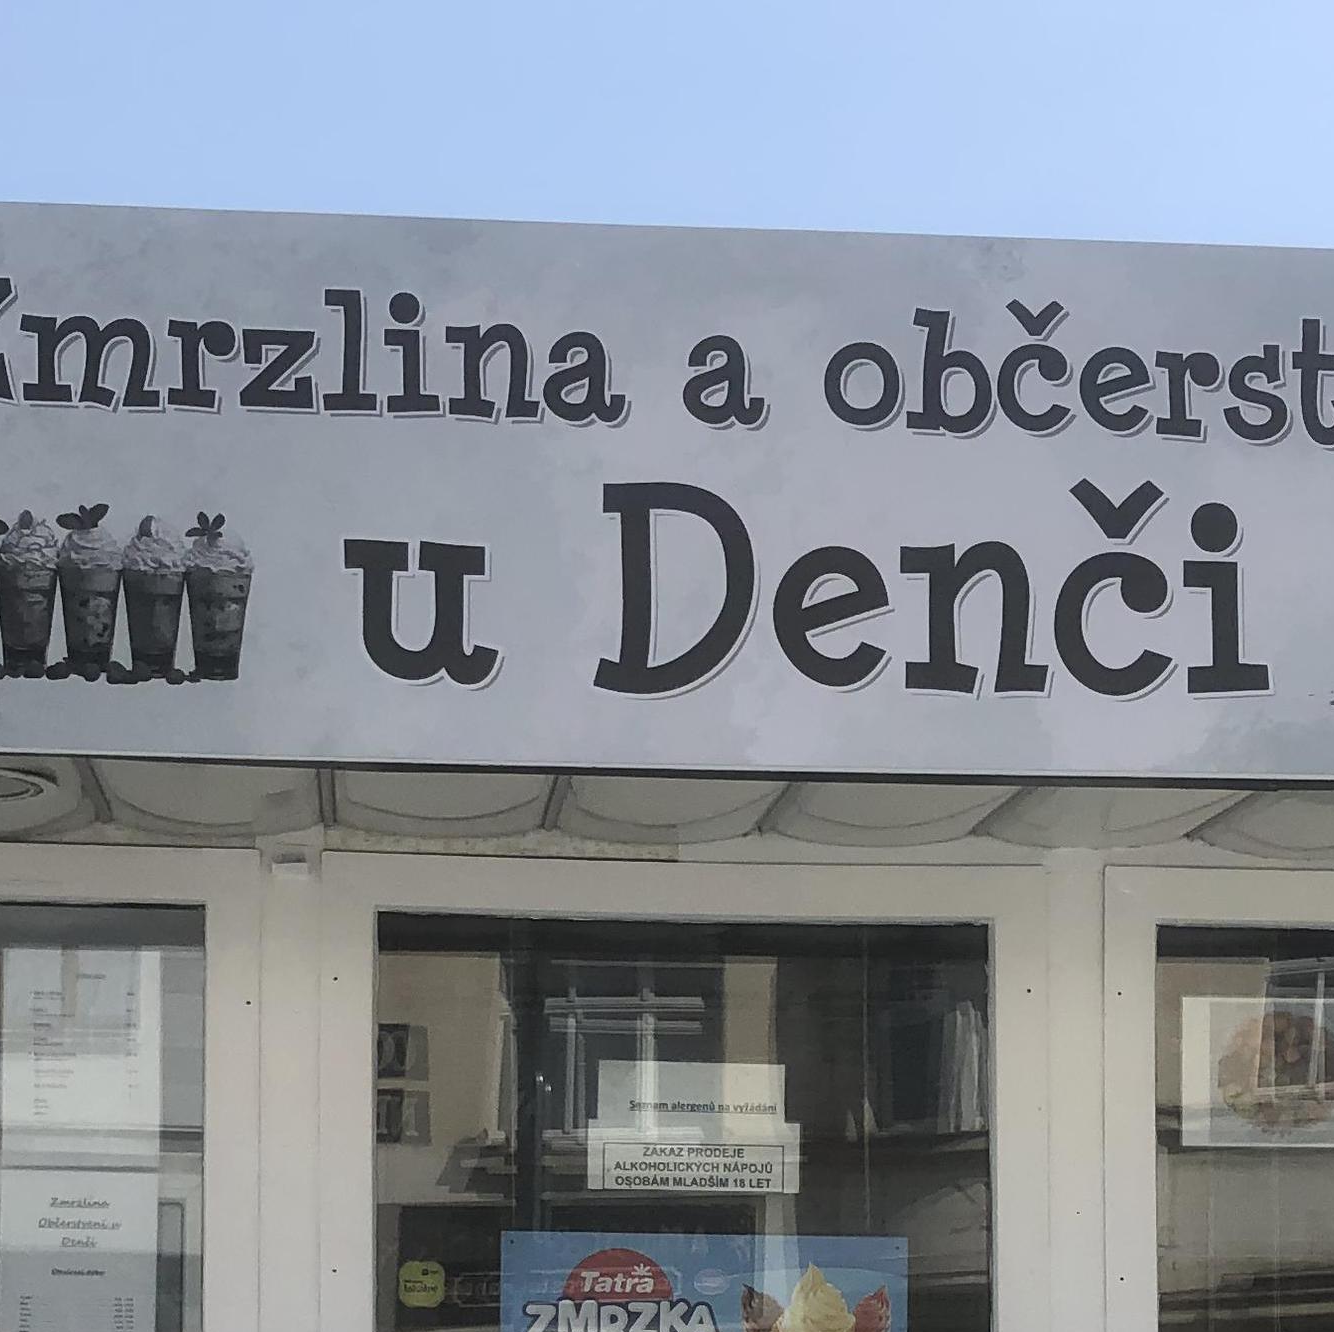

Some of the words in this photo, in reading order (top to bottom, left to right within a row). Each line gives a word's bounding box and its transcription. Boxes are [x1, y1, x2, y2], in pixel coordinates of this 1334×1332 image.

[681, 333, 766, 426] a
[344, 537, 501, 684] u
[593, 476, 1271, 697] Denči
[687, 1147, 745, 1159] PRODEJE
[614, 1160, 720, 1173] ALKOHOLICKÝCH
[723, 1161, 773, 1174] NÁPOJŮ
[615, 1174, 670, 1187] OSOBÁM
[672, 1175, 729, 1188] MLADŠÍM
[733, 1178, 746, 1188] 18
[749, 1178, 771, 1189] LET
[581, 1264, 655, 1295] Tatra
